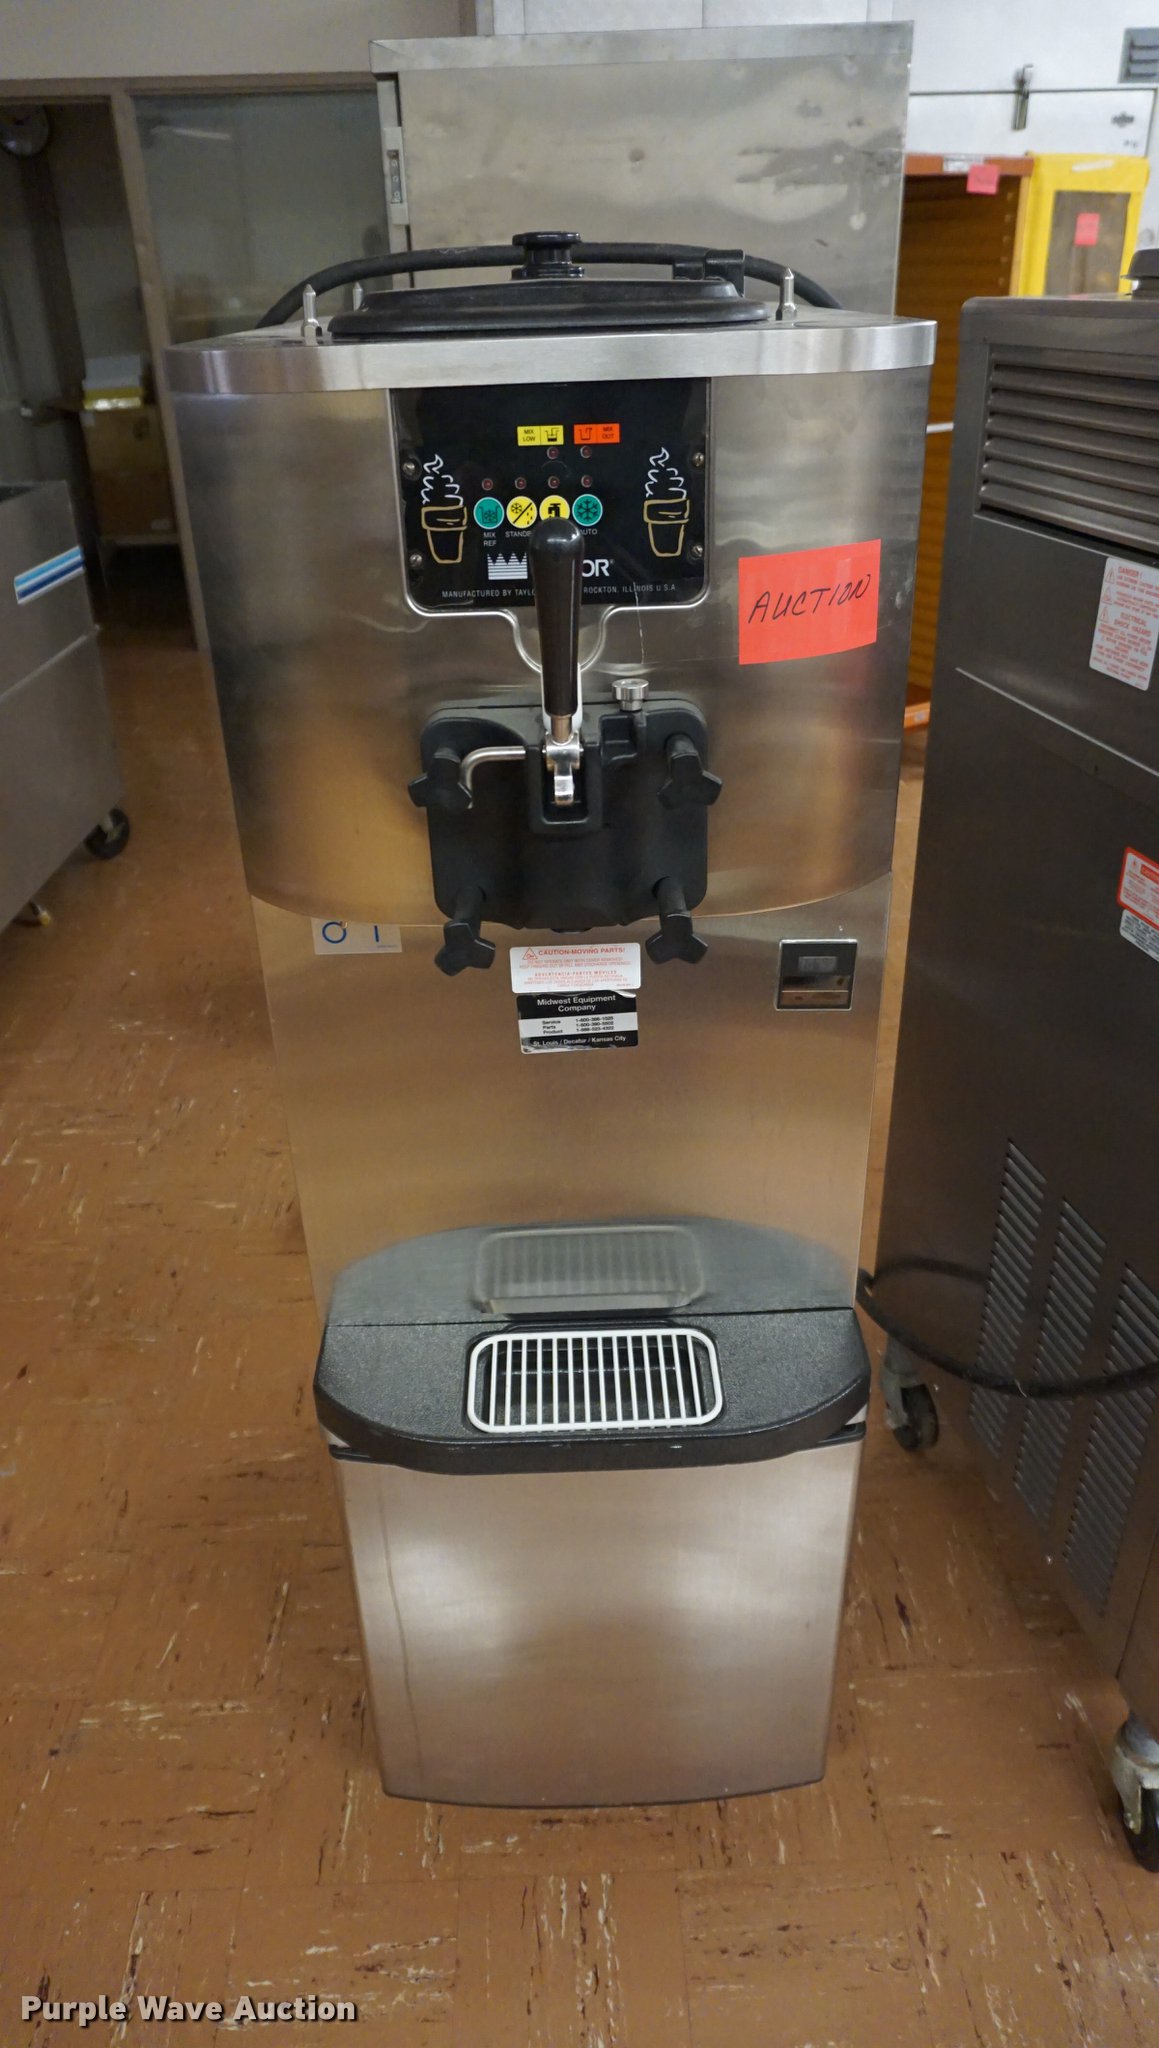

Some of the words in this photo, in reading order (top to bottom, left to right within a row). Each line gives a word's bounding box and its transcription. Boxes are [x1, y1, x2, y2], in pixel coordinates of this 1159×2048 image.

[441, 589, 500, 598] MANUFACTURED
[515, 588, 536, 597] TAYLO
[622, 583, 654, 593] ILLINOIS
[748, 573, 872, 624] AUCTION
[537, 997, 571, 1006] Midwest
[573, 994, 616, 1004] Equipment
[558, 1004, 597, 1013] Company
